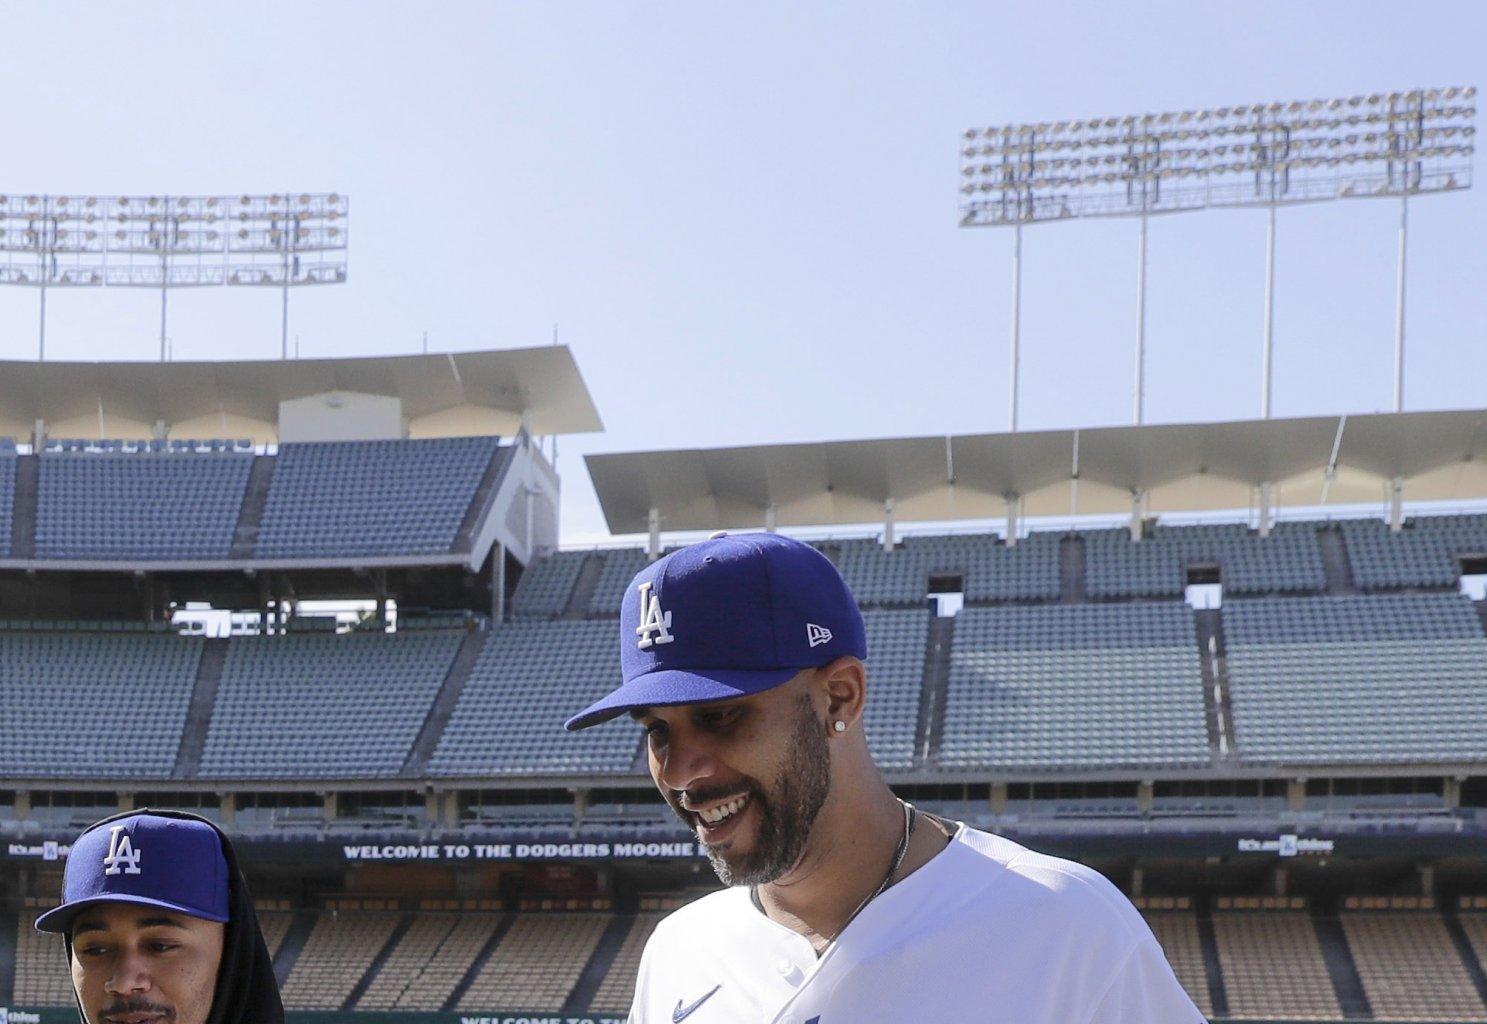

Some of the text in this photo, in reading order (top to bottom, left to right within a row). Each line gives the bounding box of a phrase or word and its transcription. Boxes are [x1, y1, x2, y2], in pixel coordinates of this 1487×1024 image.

[636, 582, 675, 649] LA
[103, 825, 141, 876] LA
[344, 845, 440, 859] WELCOME
[443, 845, 471, 859] TO
[474, 844, 512, 859] THE
[515, 843, 611, 858] DODGERS
[613, 842, 694, 857] MOOKIE
